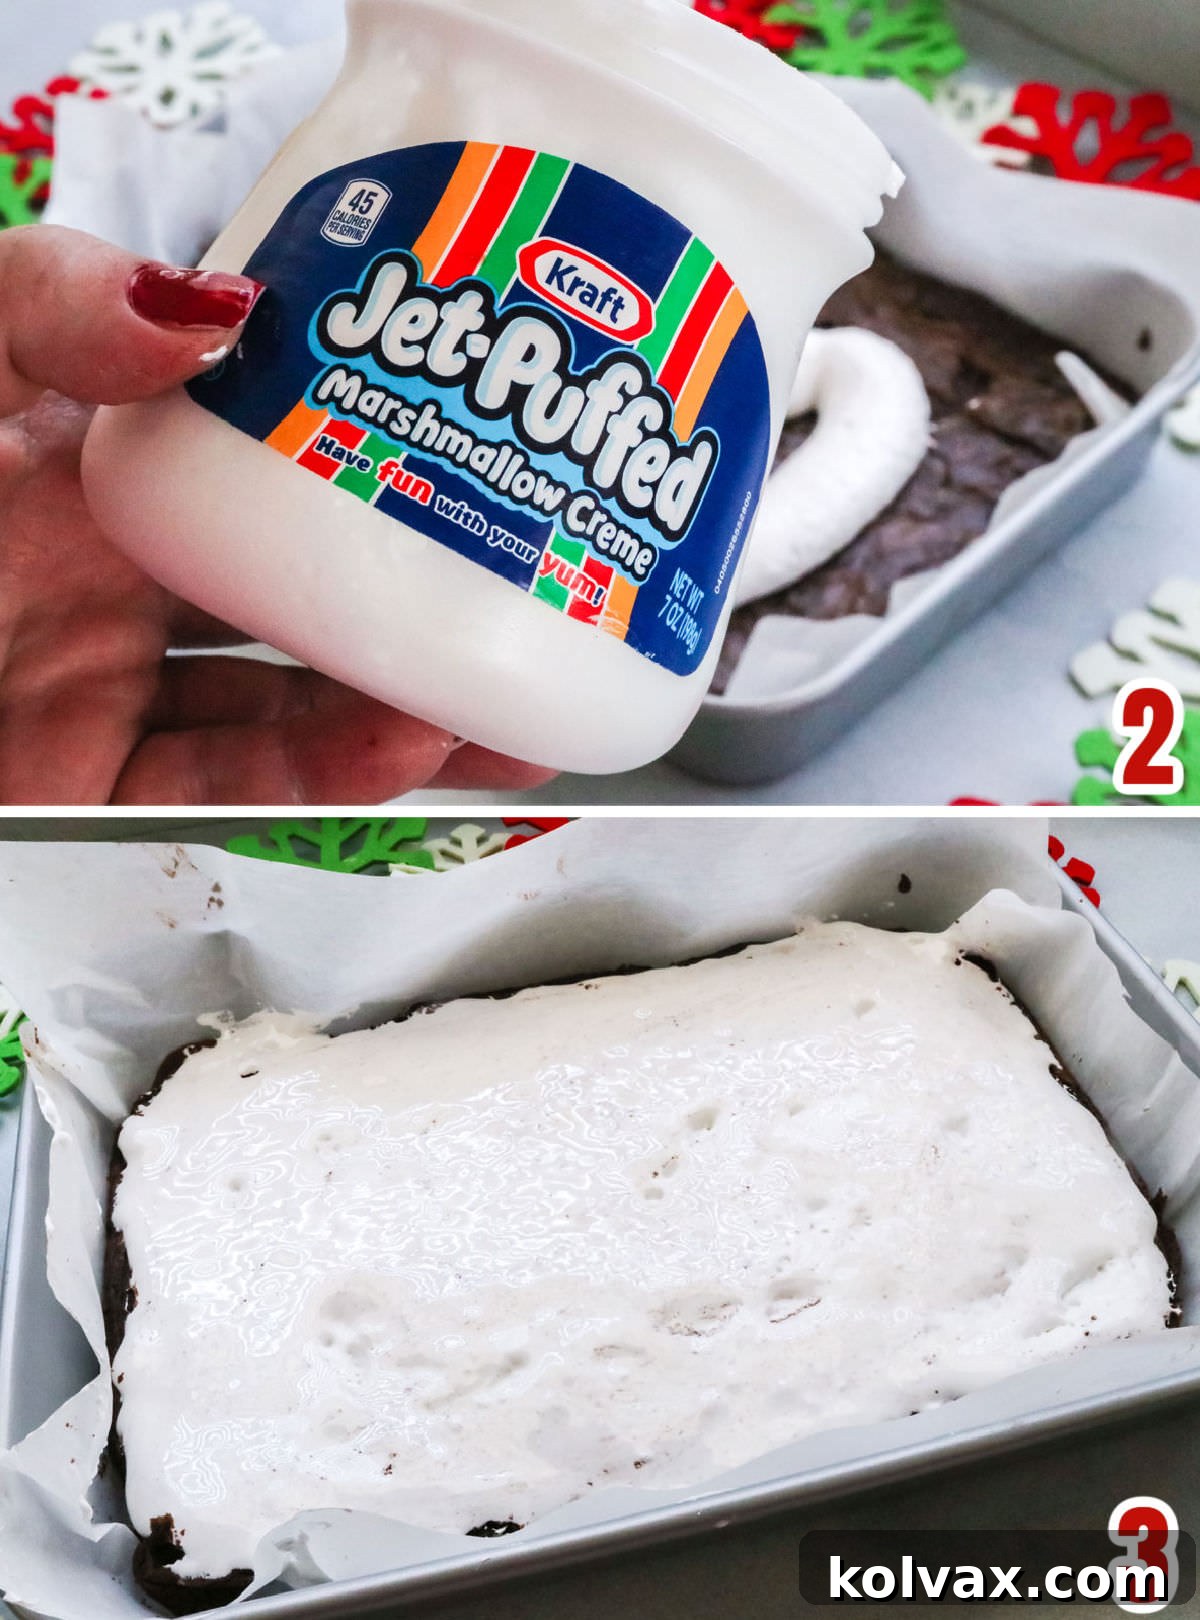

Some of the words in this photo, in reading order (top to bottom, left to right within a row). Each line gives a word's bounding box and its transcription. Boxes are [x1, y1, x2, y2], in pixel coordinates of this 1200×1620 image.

[325, 221, 341, 234] PER
[337, 223, 366, 241] SERVING
[331, 210, 372, 230] CALORIES
[348, 188, 379, 215] 45
[545, 257, 625, 324] Kraft
[324, 259, 714, 532] Jet-Puffed
[316, 367, 566, 511] Marshmallow
[565, 495, 653, 576] Creme
[315, 435, 371, 471] Have
[376, 459, 433, 504] fun
[436, 496, 486, 535] with
[488, 527, 539, 563] your
[538, 552, 606, 606] yum!
[669, 567, 693, 602] NET
[687, 583, 704, 615] WT
[658, 594, 672, 618] 7
[666, 602, 684, 632] OZ
[676, 612, 703, 655] (198g)
